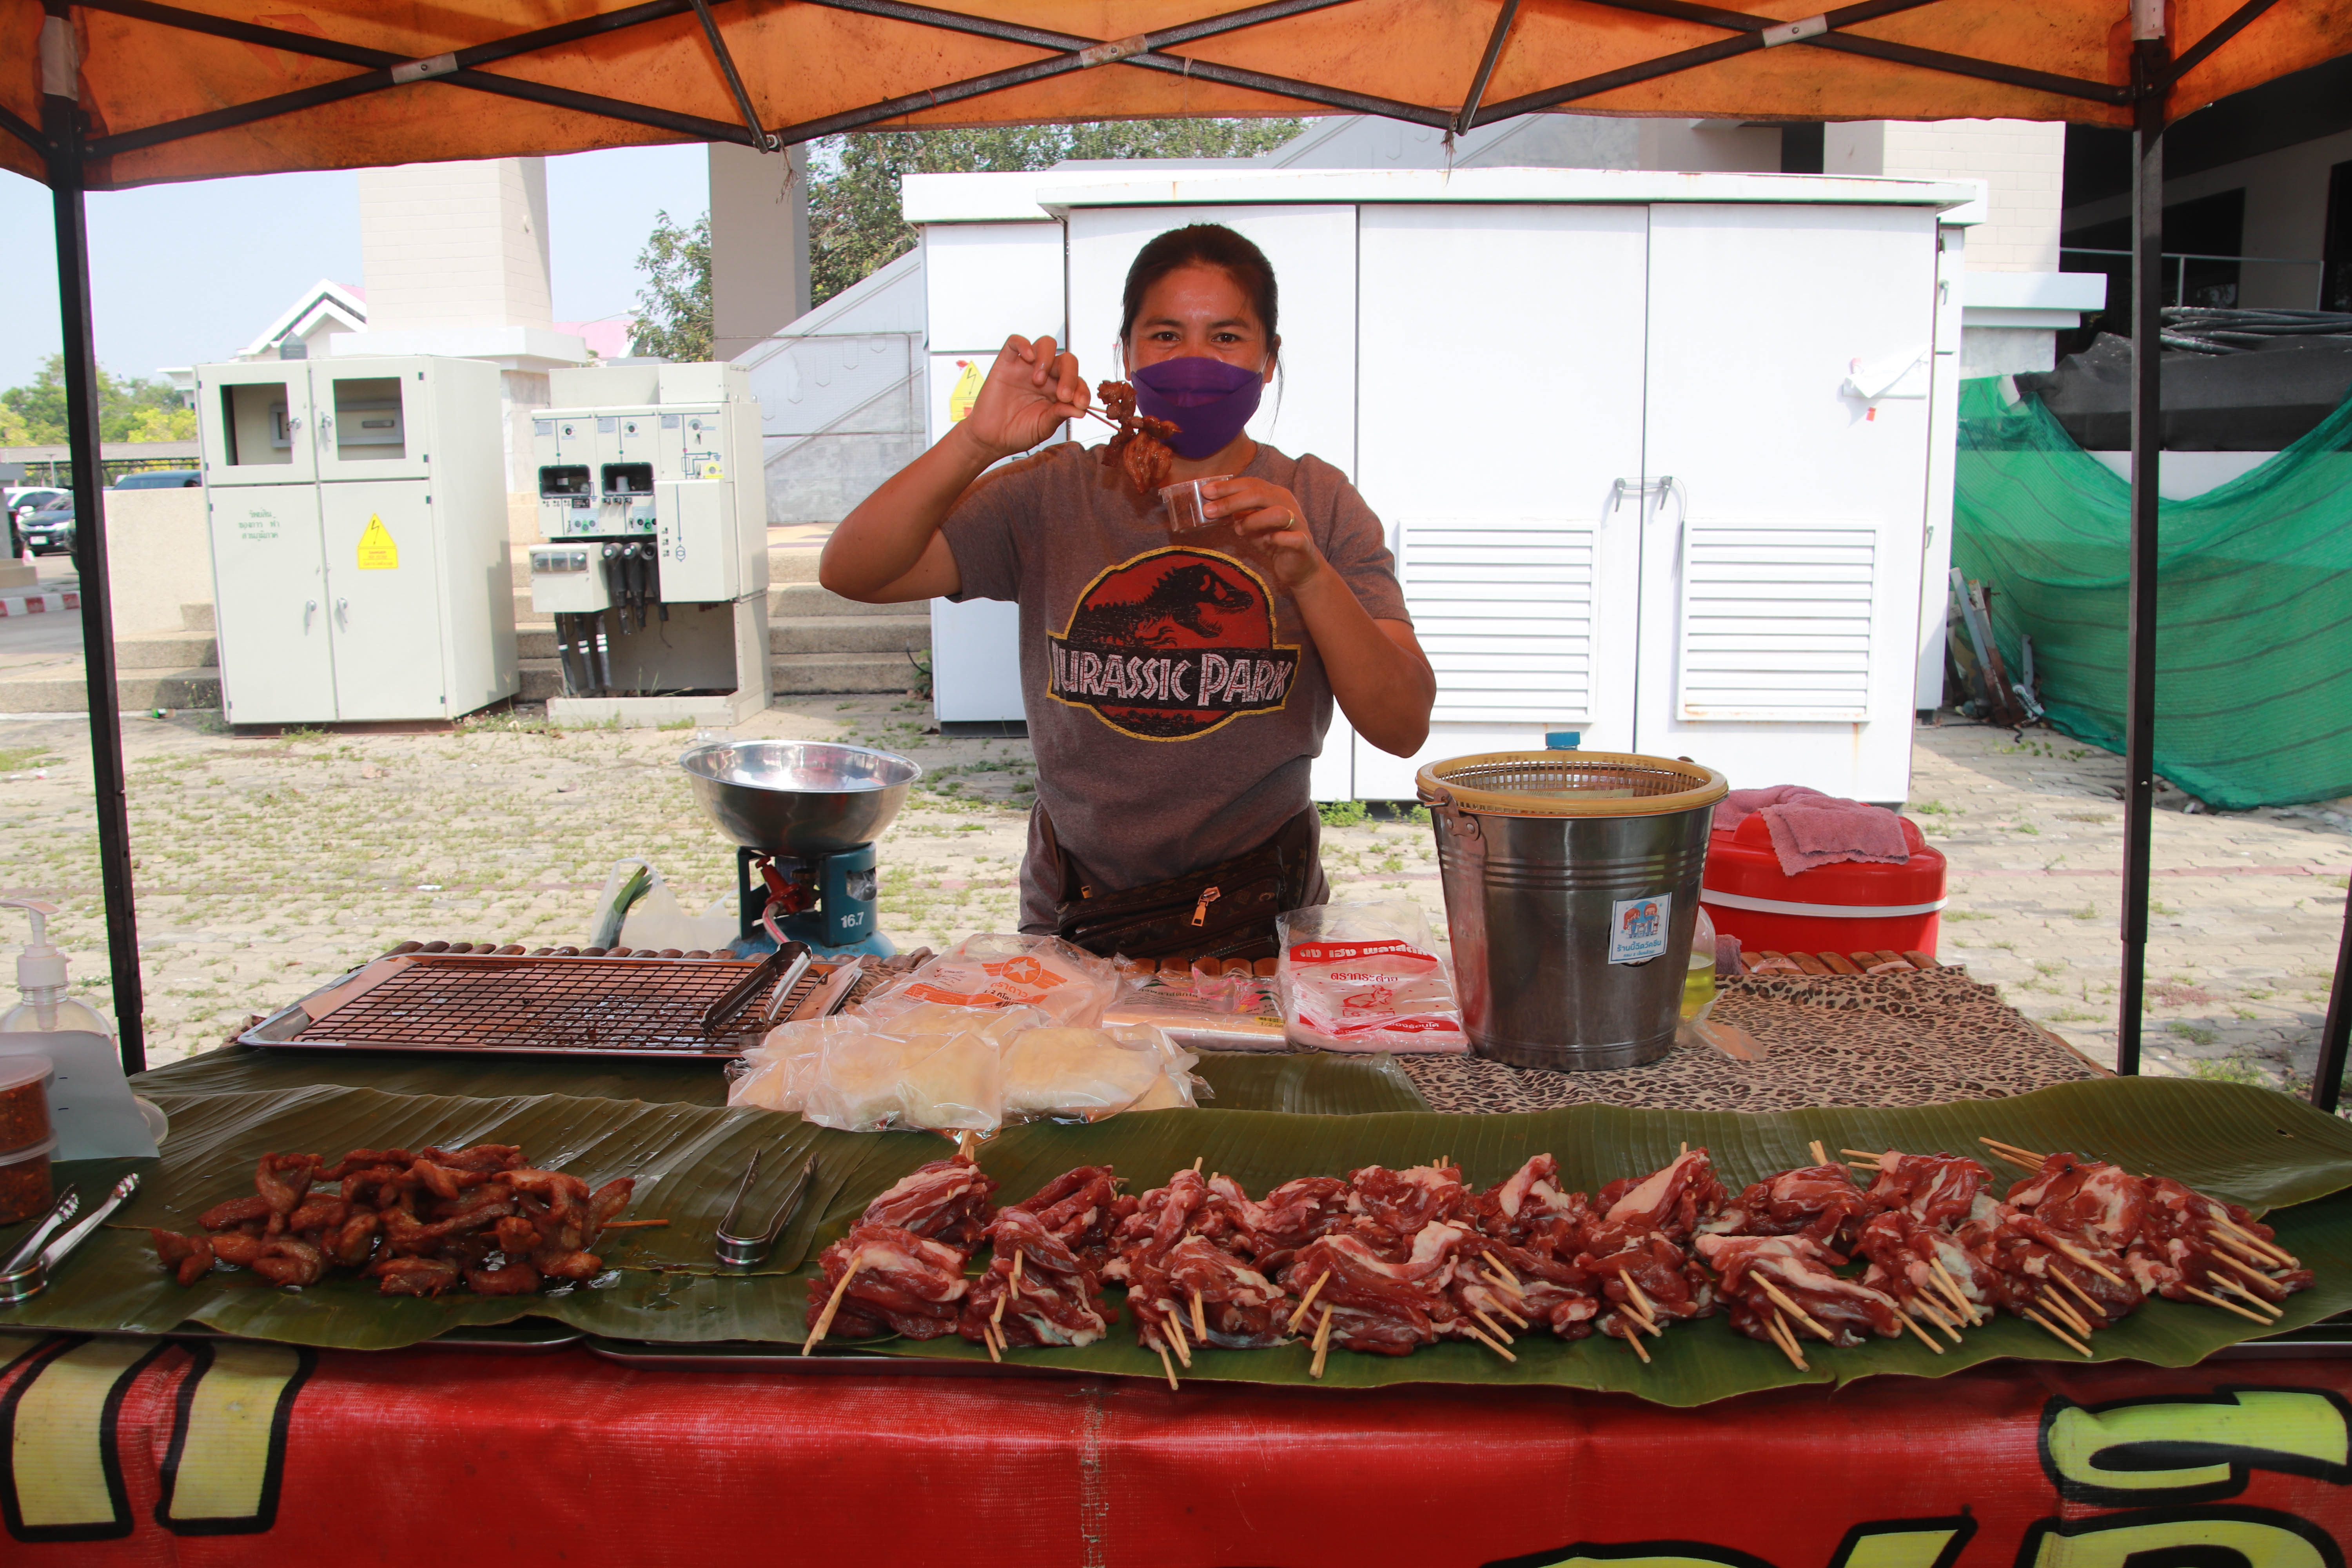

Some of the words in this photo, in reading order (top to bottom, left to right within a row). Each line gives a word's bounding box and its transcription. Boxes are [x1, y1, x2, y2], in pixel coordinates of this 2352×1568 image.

[1051, 641, 1191, 701] JURASSIC
[1197, 653, 1293, 706] PARK
[840, 911, 864, 928] 16.7
[1331, 973, 1398, 982] ตรากระต่าย
